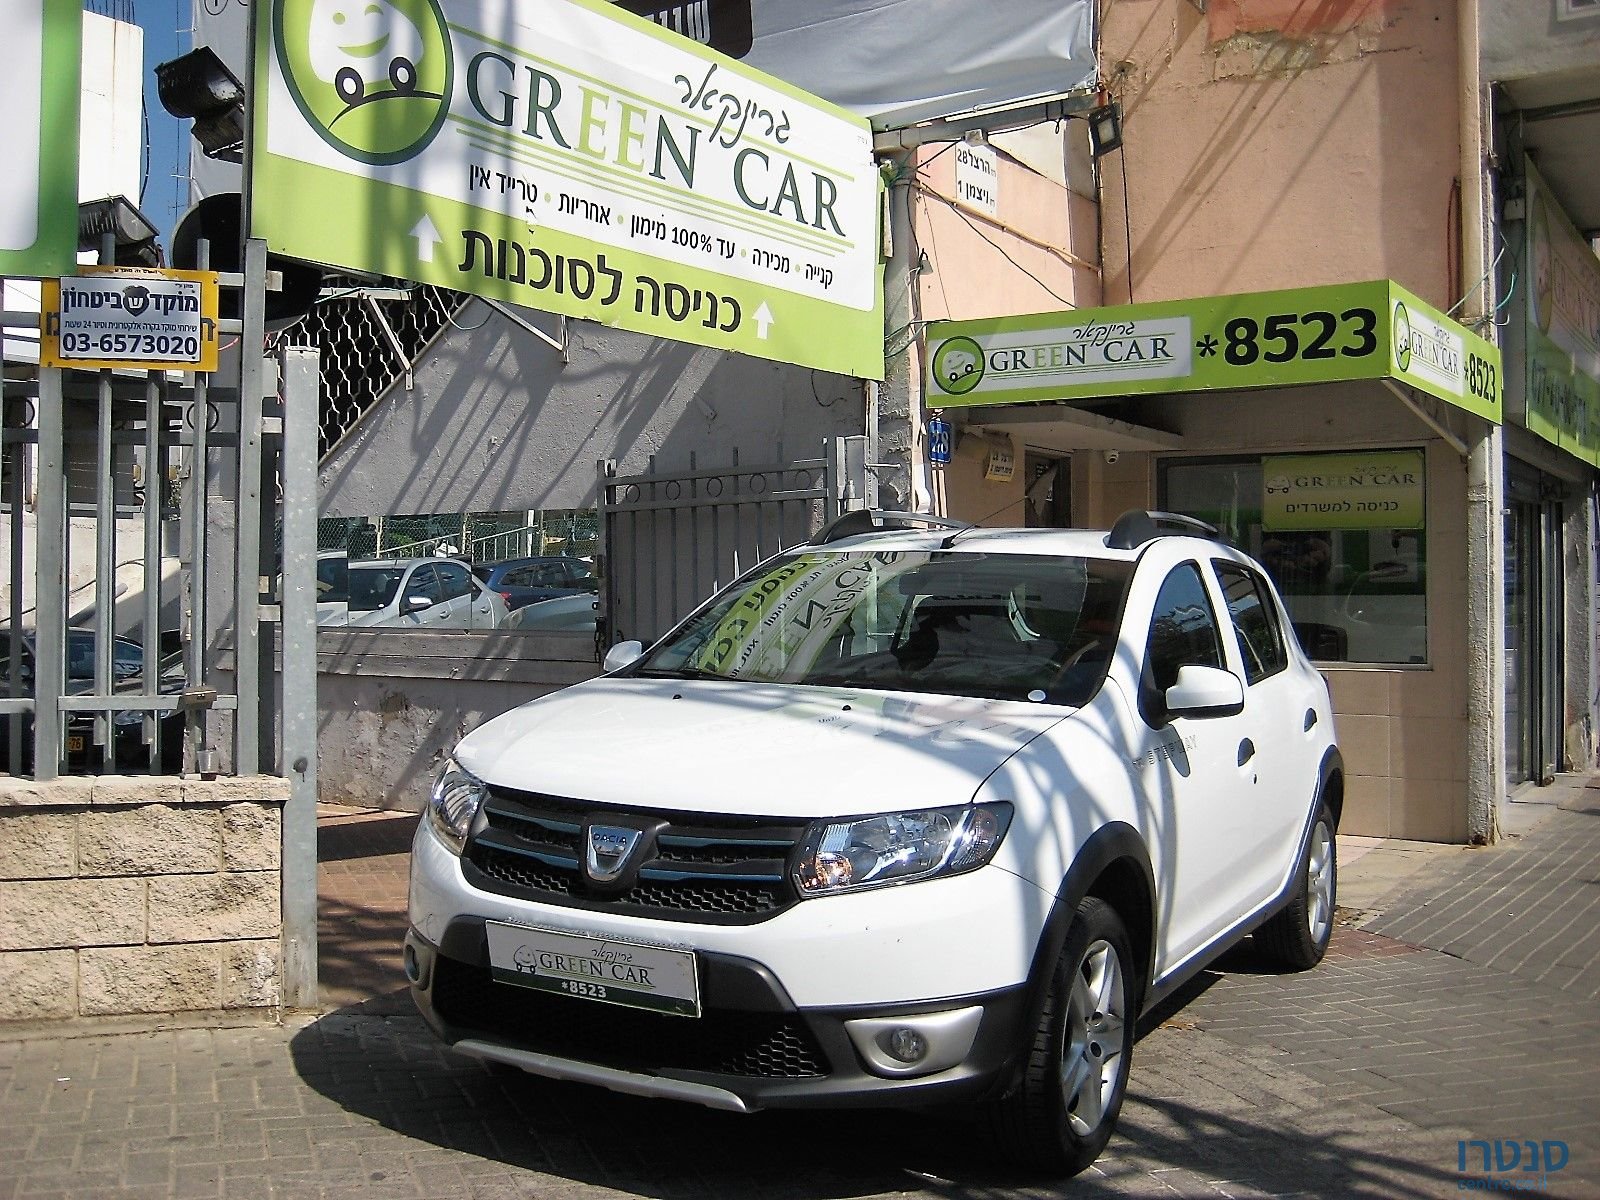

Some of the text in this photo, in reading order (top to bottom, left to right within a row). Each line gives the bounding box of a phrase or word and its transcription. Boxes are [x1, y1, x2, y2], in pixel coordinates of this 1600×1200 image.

[674, 62, 791, 149] גרינקאר
[466, 50, 846, 237] GREEN CAR
[957, 180, 962, 193] 1
[965, 182, 989, 204] ויצמן
[469, 164, 834, 290] קנייה מכירה עד 100% מימון אחריות טרייד אין
[458, 230, 742, 333] כניסה לסוכנות
[62, 290, 123, 313] ביטחון
[149, 293, 199, 316] מוקד
[83, 320, 92, 329] 24
[1072, 318, 1135, 347] גרינקאר
[62, 332, 198, 356] 03-6573020
[989, 337, 1174, 372] GREEN CAR
[1442, 347, 1459, 376] CAR
[1295, 473, 1416, 488] GREEN CAR
[1286, 500, 1399, 513] כניסה למשרדים
[592, 832, 628, 845] DACIA
[539, 952, 653, 986] GREEN CAR
